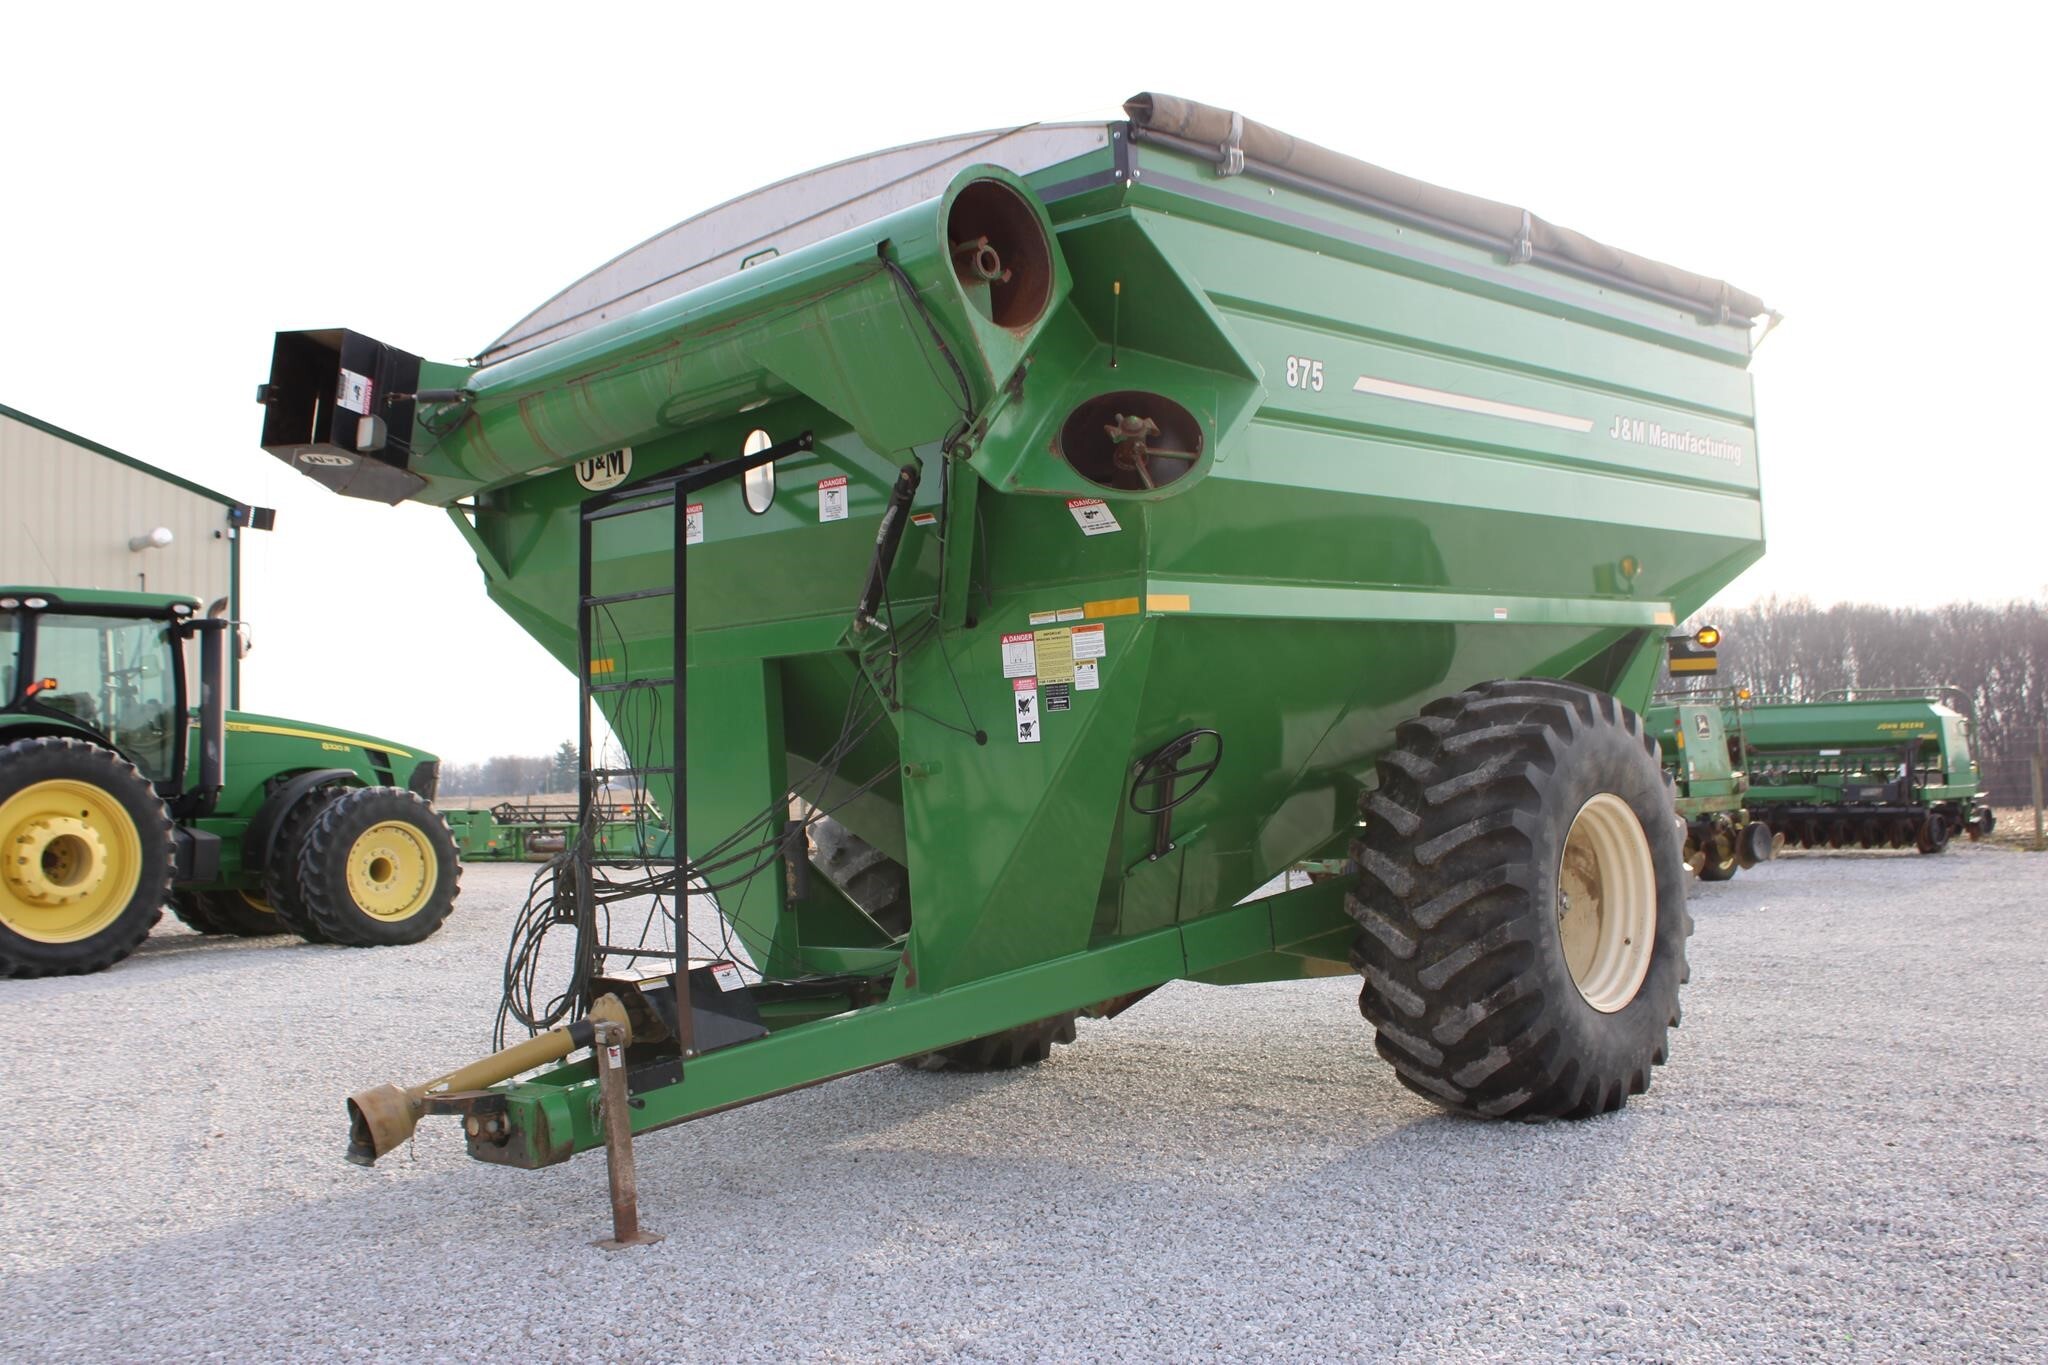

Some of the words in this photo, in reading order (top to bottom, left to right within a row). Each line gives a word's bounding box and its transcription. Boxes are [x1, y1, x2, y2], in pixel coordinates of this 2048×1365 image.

[1286, 355, 1324, 392] 875
[1609, 415, 1646, 444] J&M
[1648, 422, 1743, 467] Manufacturing
[824, 477, 847, 488] DANGER
[1009, 633, 1033, 643] DANGER
